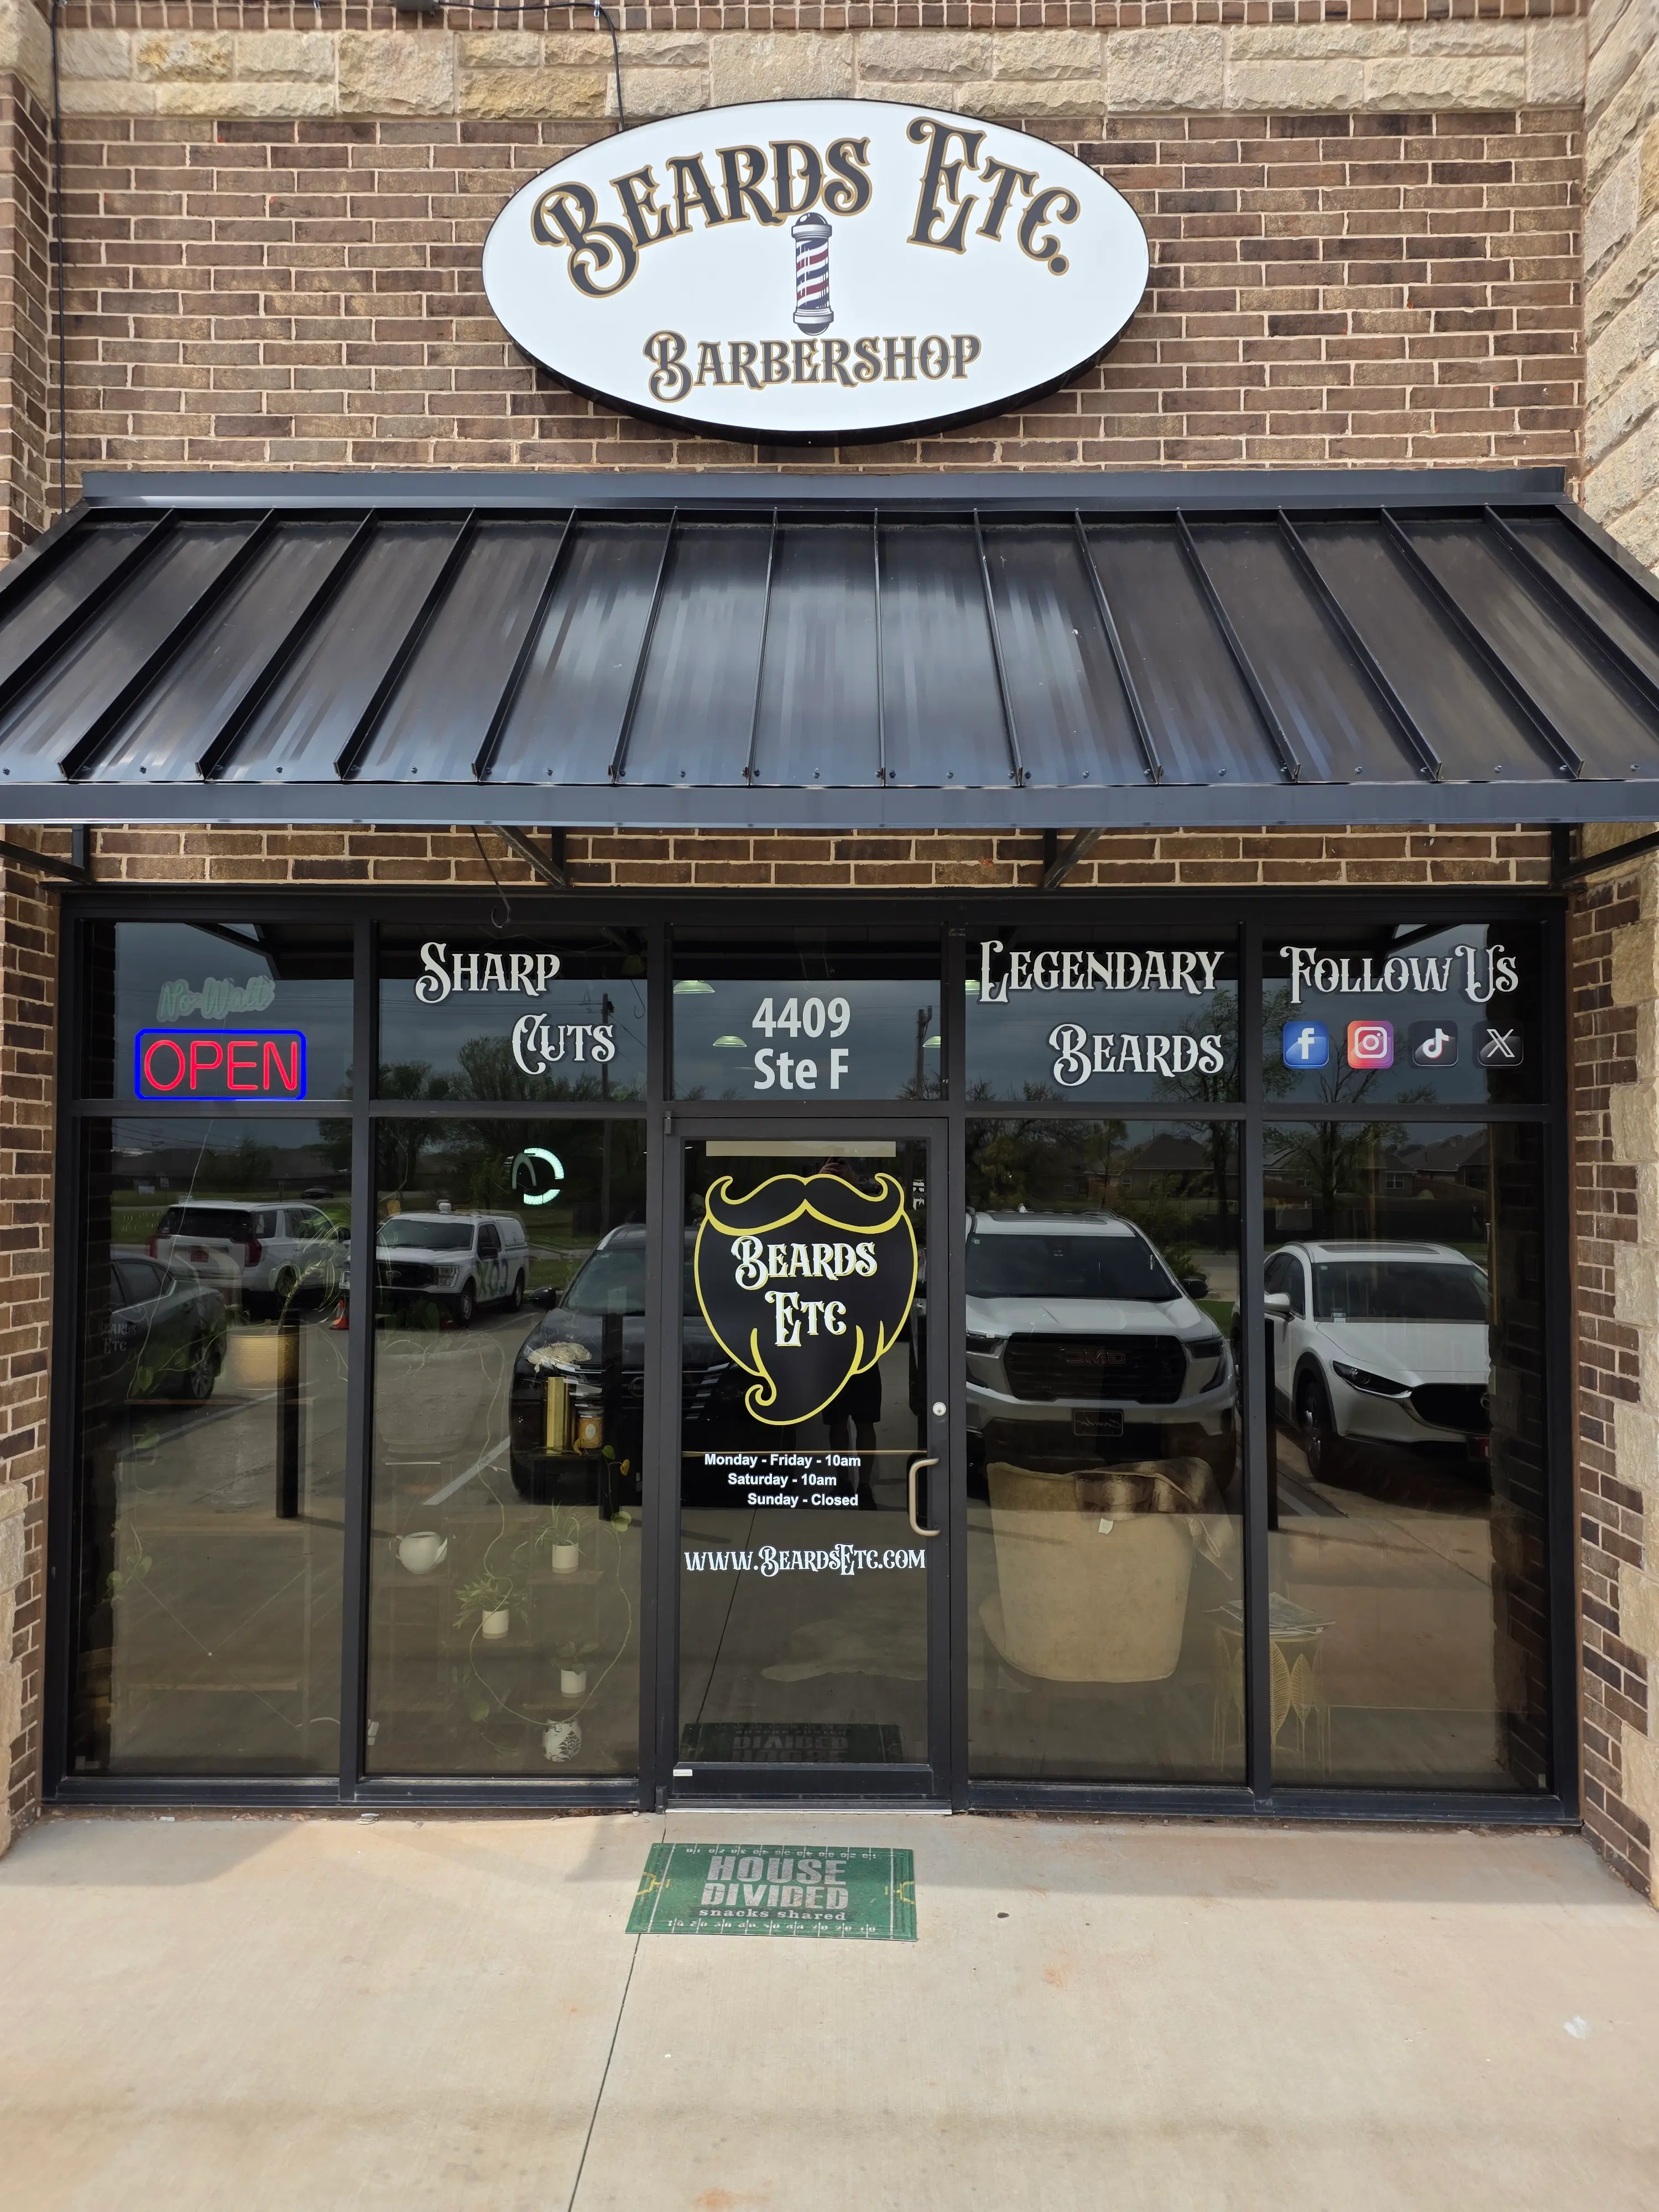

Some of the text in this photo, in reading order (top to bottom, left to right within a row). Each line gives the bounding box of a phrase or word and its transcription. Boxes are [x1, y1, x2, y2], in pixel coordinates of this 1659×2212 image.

[529, 136, 873, 299] BEARDS
[643, 330, 982, 403] BARBERSHOP
[415, 942, 560, 1004] SHARP
[978, 940, 1225, 1003] LEGENDARY
[1280, 945, 1519, 1004] FOLLOW US
[512, 1013, 615, 1074] CUTS
[752, 997, 851, 1038] 4409
[144, 1040, 298, 1091] OPEN
[754, 1048, 849, 1089] Ste F
[1048, 1024, 1224, 1086] BEARDS
[731, 1235, 878, 1290] BEARDS
[764, 1290, 847, 1347] ETC
[704, 1453, 758, 1469] Monday
[770, 1453, 813, 1469] Friday
[825, 1454, 862, 1467] 10am
[728, 1473, 789, 1488] Saturday
[801, 1473, 837, 1486] 10am
[747, 1493, 799, 1508] Sunday
[811, 1493, 859, 1506] Closed
[700, 1882, 848, 1910] DIVIDED
[707, 1855, 847, 1885] HOUSE
[698, 1908, 846, 1921] snacks shared
